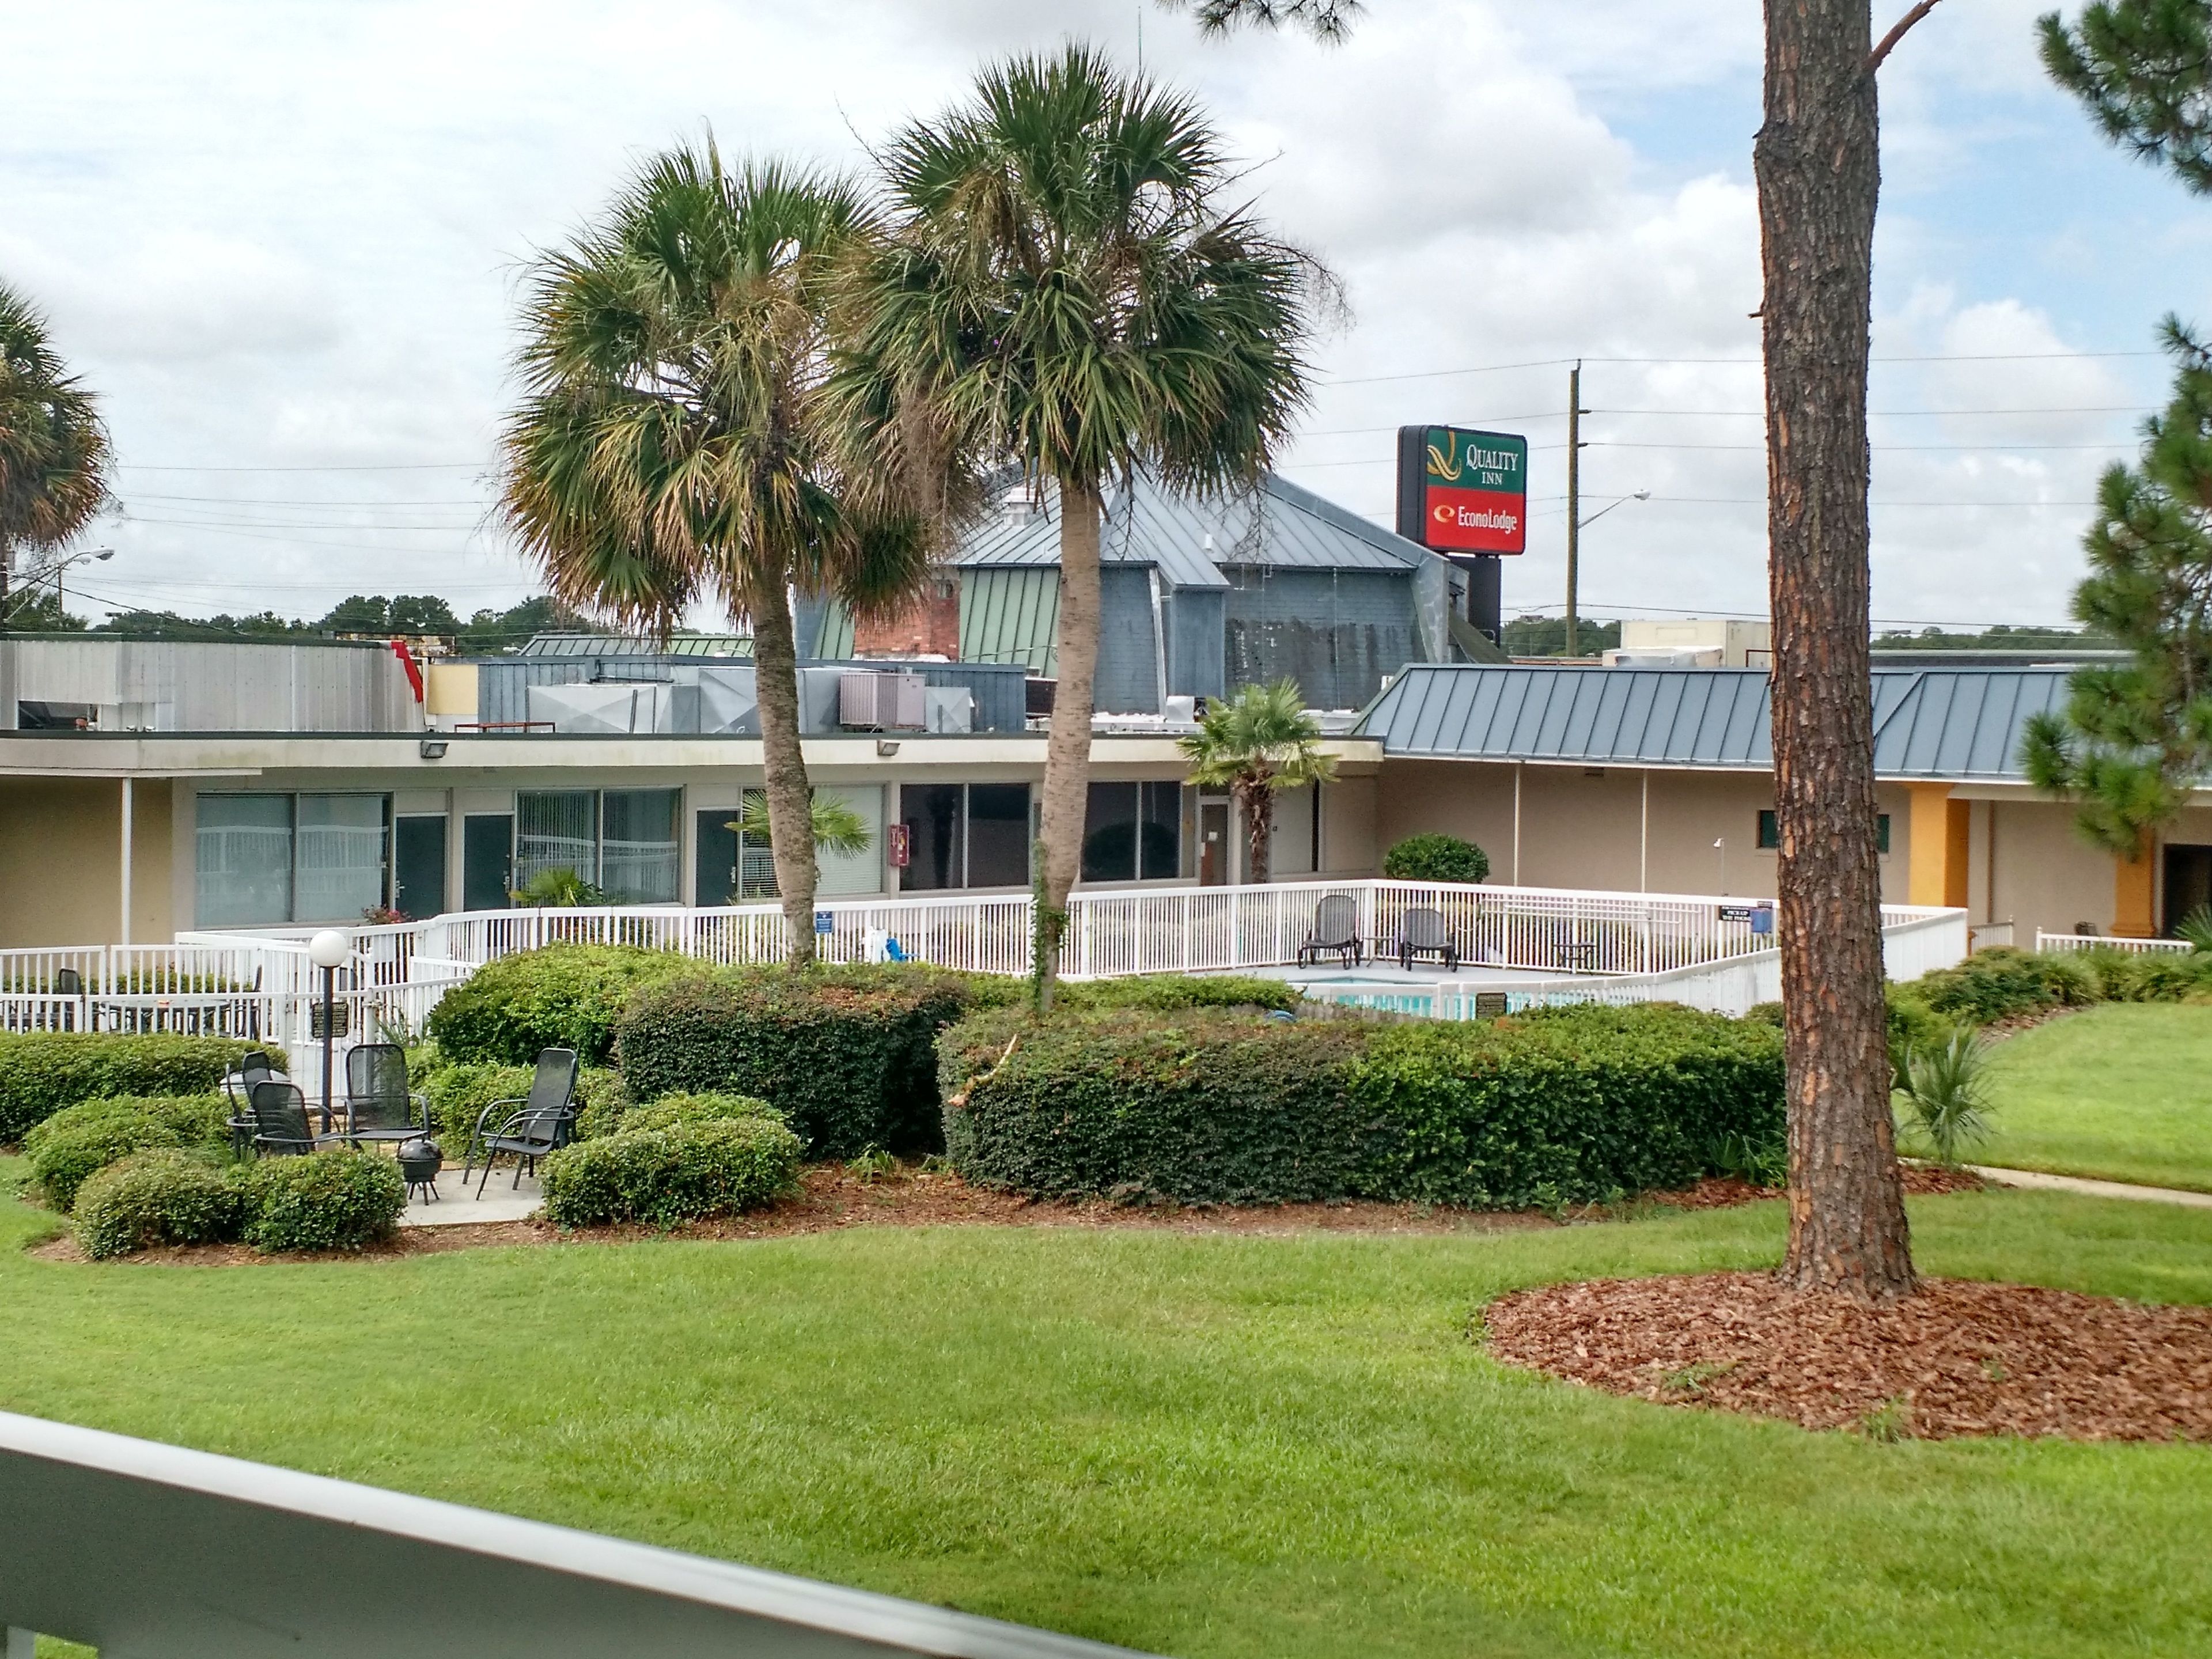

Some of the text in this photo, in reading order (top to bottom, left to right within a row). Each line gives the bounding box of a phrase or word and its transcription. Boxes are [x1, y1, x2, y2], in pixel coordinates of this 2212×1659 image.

[1466, 444, 1518, 471] QUALITY
[1482, 472, 1503, 485] INN
[1458, 506, 1518, 535] EconoLodge
